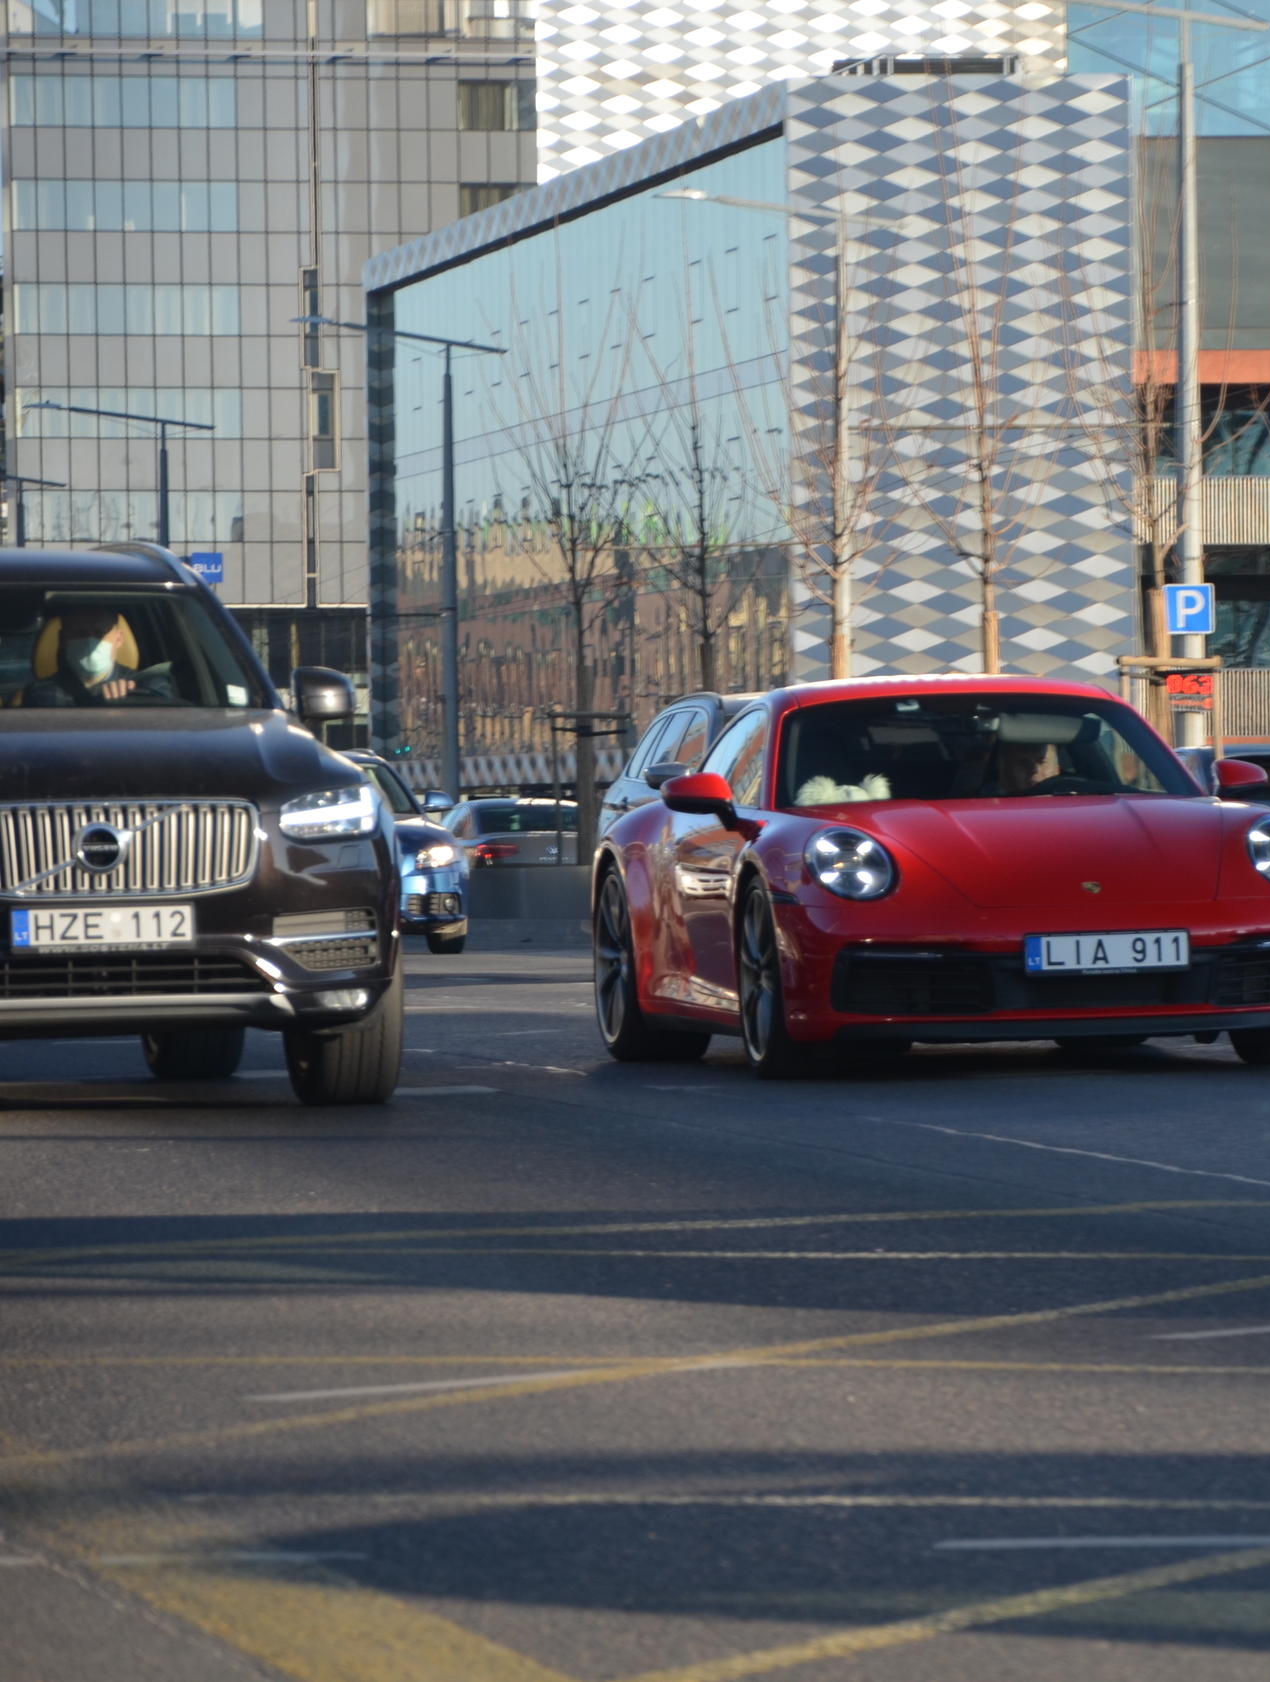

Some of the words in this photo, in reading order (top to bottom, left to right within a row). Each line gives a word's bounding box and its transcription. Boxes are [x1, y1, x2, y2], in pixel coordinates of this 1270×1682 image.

[1176, 589, 1206, 629] P
[14, 931, 29, 941] LT
[34, 911, 104, 941] HZE
[132, 910, 186, 938] 112
[1028, 957, 1041, 965] LT
[1046, 938, 1109, 966] LIA
[1132, 935, 1180, 963] 911
